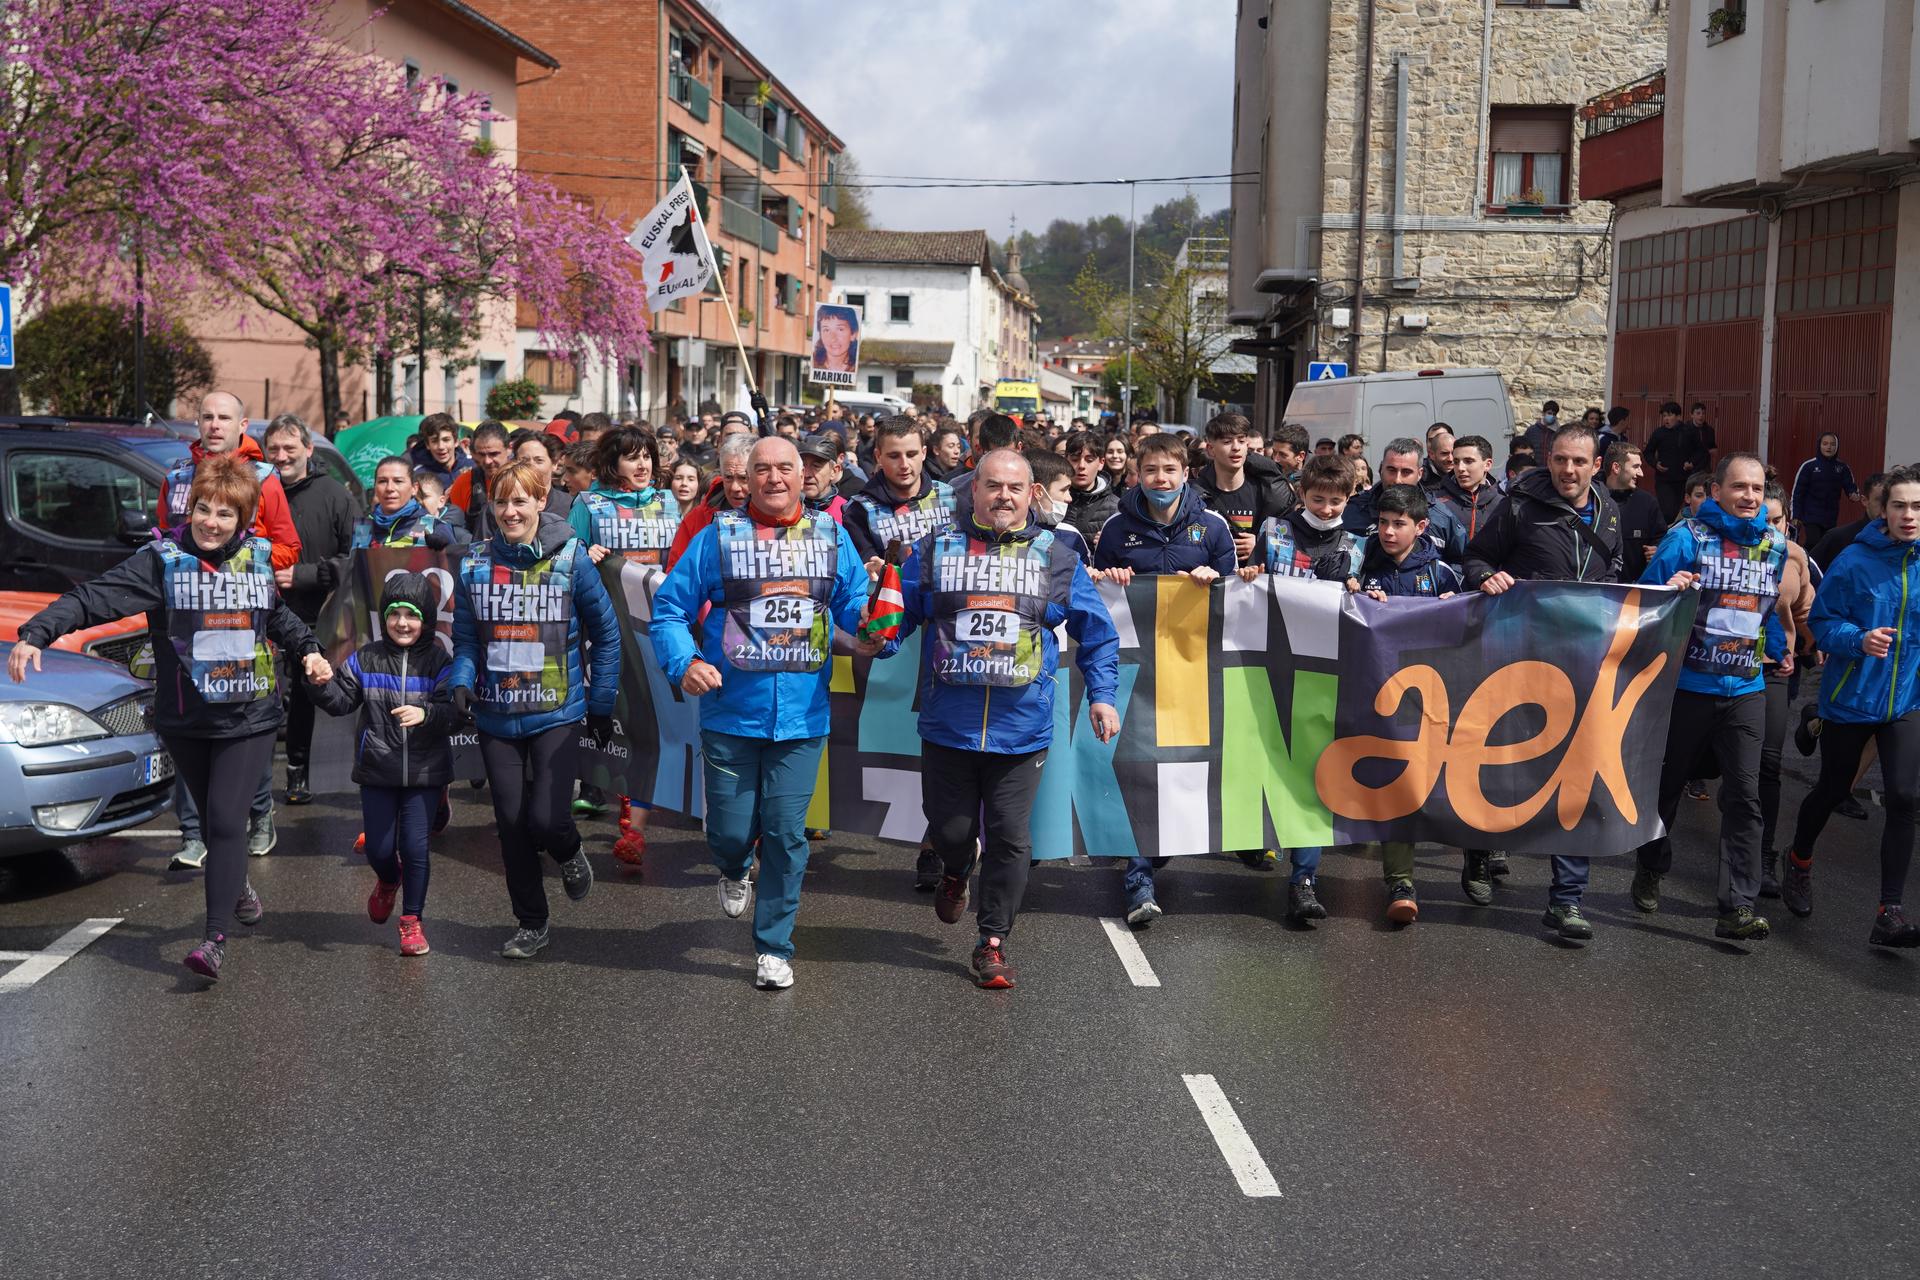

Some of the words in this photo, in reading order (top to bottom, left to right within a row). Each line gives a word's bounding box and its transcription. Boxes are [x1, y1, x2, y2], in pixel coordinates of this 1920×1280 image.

[641, 209, 673, 249] EUSKAL
[669, 190, 690, 211] PRES
[658, 278, 695, 295] EUSKAL
[813, 370, 853, 383] MARIXOL
[730, 539, 828, 578] HITZEKIN
[940, 555, 1041, 596] HITZEKIN
[174, 571, 270, 610] HITZEKIN
[469, 583, 563, 621] HITZEKIN
[764, 600, 802, 624] 254
[970, 599, 1003, 607] euskaltel
[208, 616, 242, 625] euskaltel
[969, 613, 1007, 637] 254
[768, 630, 792, 646] aek
[1719, 640, 1740, 653] aek
[735, 640, 822, 662] 22.korrika
[969, 643, 994, 659] aek
[211, 663, 236, 678] aek
[940, 653, 1030, 678] 22.korrika
[501, 674, 521, 688] aek
[479, 683, 557, 704] 22.korrika
[1315, 588, 1667, 833] aek
